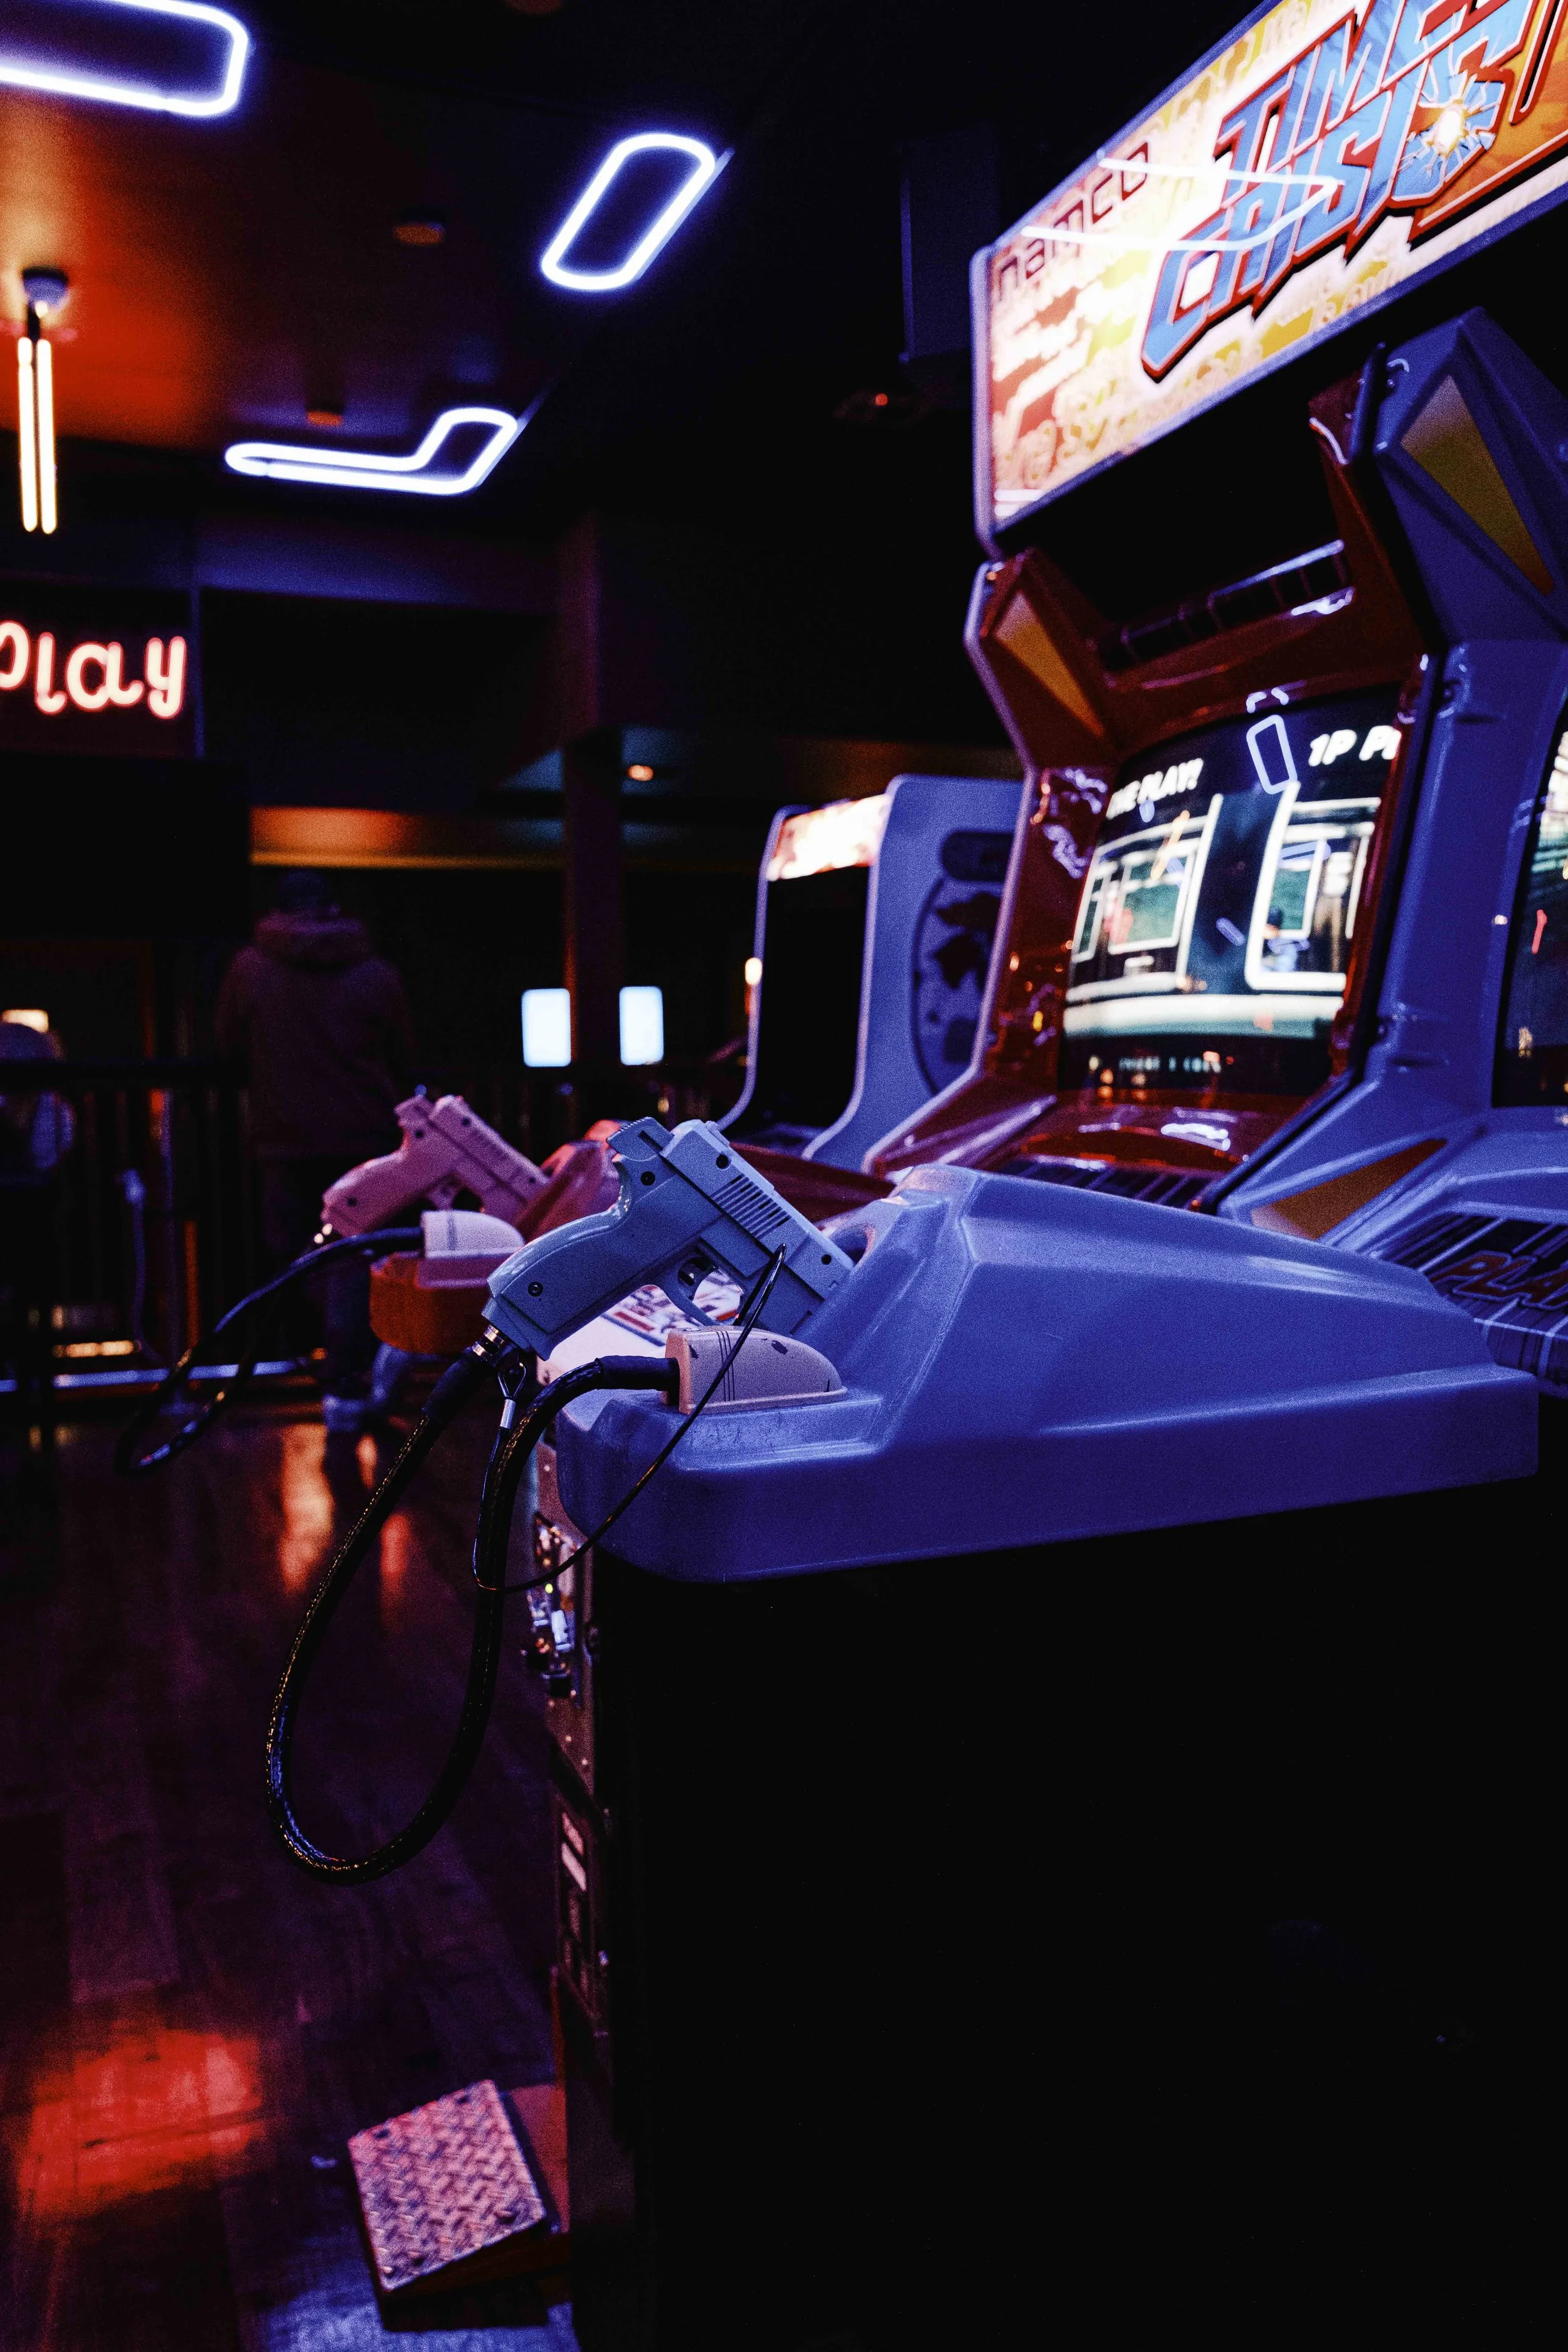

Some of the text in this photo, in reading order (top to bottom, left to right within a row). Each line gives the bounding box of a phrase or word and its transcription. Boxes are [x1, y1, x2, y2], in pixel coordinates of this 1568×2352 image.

[999, 141, 1148, 302] namco
[1142, 0, 1530, 379] CRISIS
[1308, 729, 1357, 766] 1P
